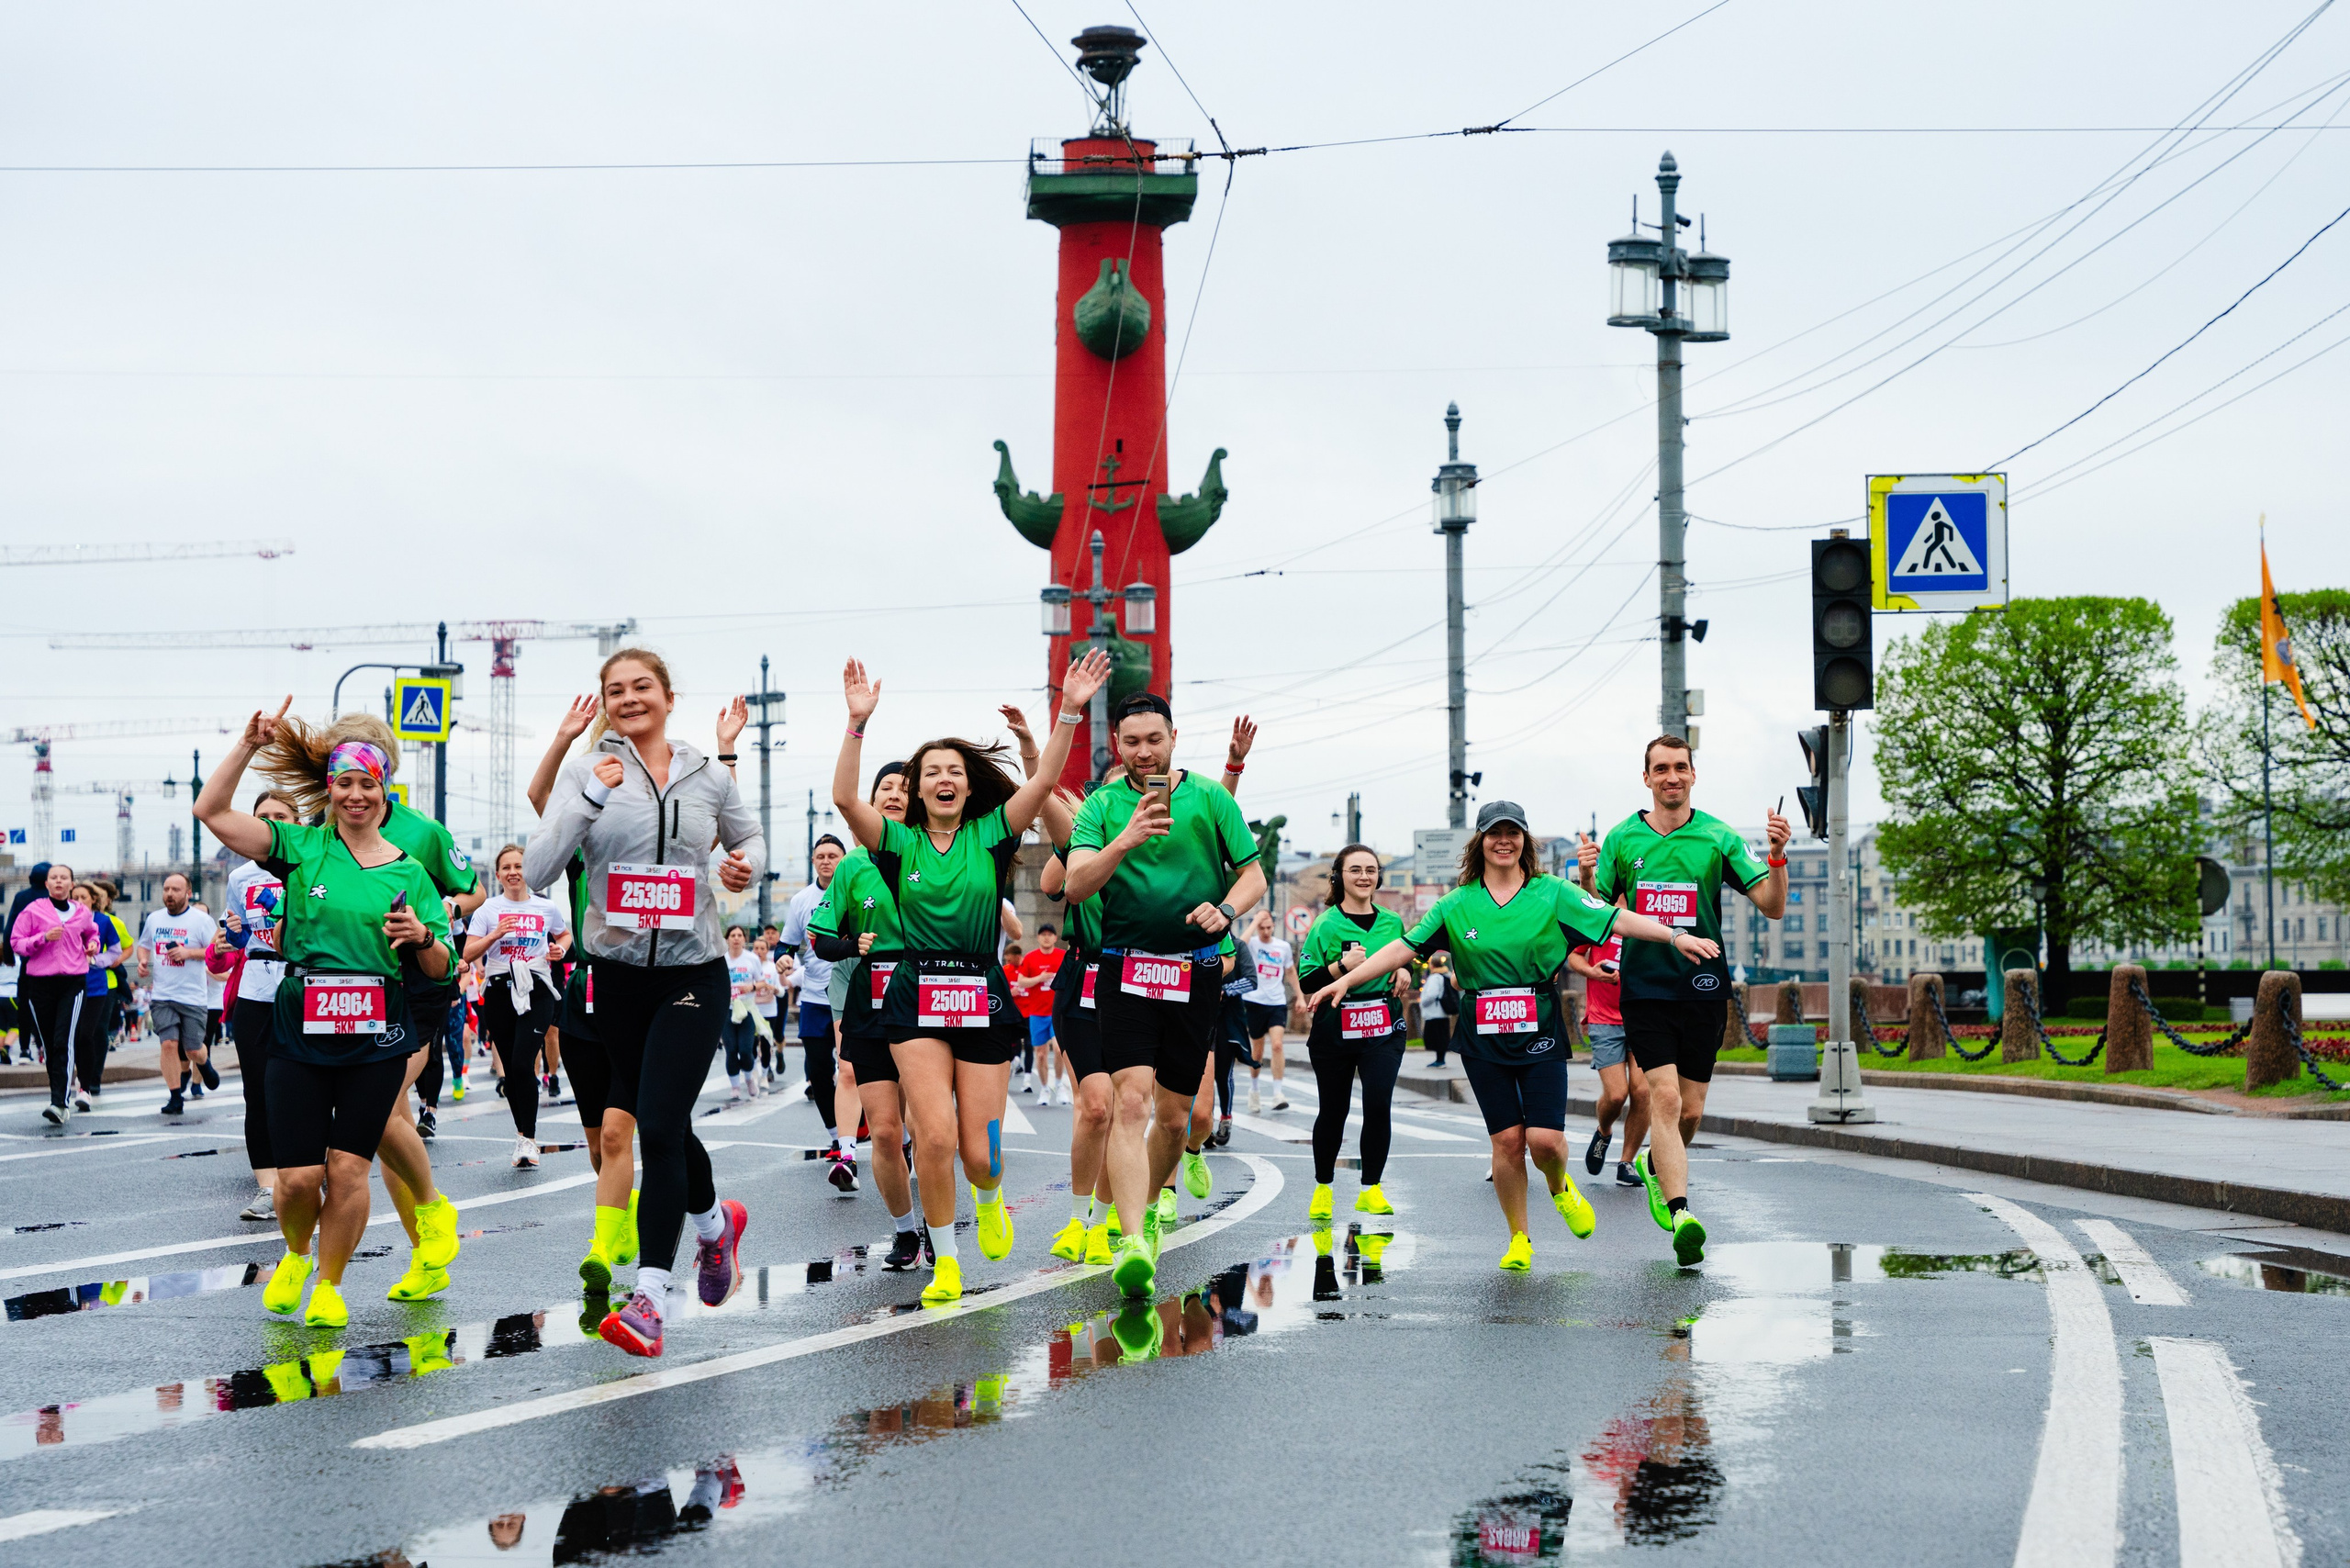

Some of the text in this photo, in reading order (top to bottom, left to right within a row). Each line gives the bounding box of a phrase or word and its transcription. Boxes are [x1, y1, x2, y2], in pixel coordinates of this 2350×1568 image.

[670, 871, 677, 879] E
[620, 880, 681, 911] 25366
[1645, 893, 1687, 913] 24959
[518, 915, 537, 930] 443
[638, 913, 661, 929] 5KM
[1659, 915, 1674, 926] 5KM
[934, 959, 965, 969] TRAIL
[1132, 961, 1181, 987] 25000
[930, 989, 977, 1012] 25001
[1146, 987, 1164, 1001] 5KM
[316, 991, 374, 1016] 24964
[1484, 1000, 1528, 1021] 24986
[945, 1015, 963, 1027] 5KM
[1349, 1009, 1384, 1028] 24965
[334, 1020, 355, 1035] 5KM
[1362, 1028, 1375, 1038] 5KM
[1498, 1022, 1515, 1034] 5KM
